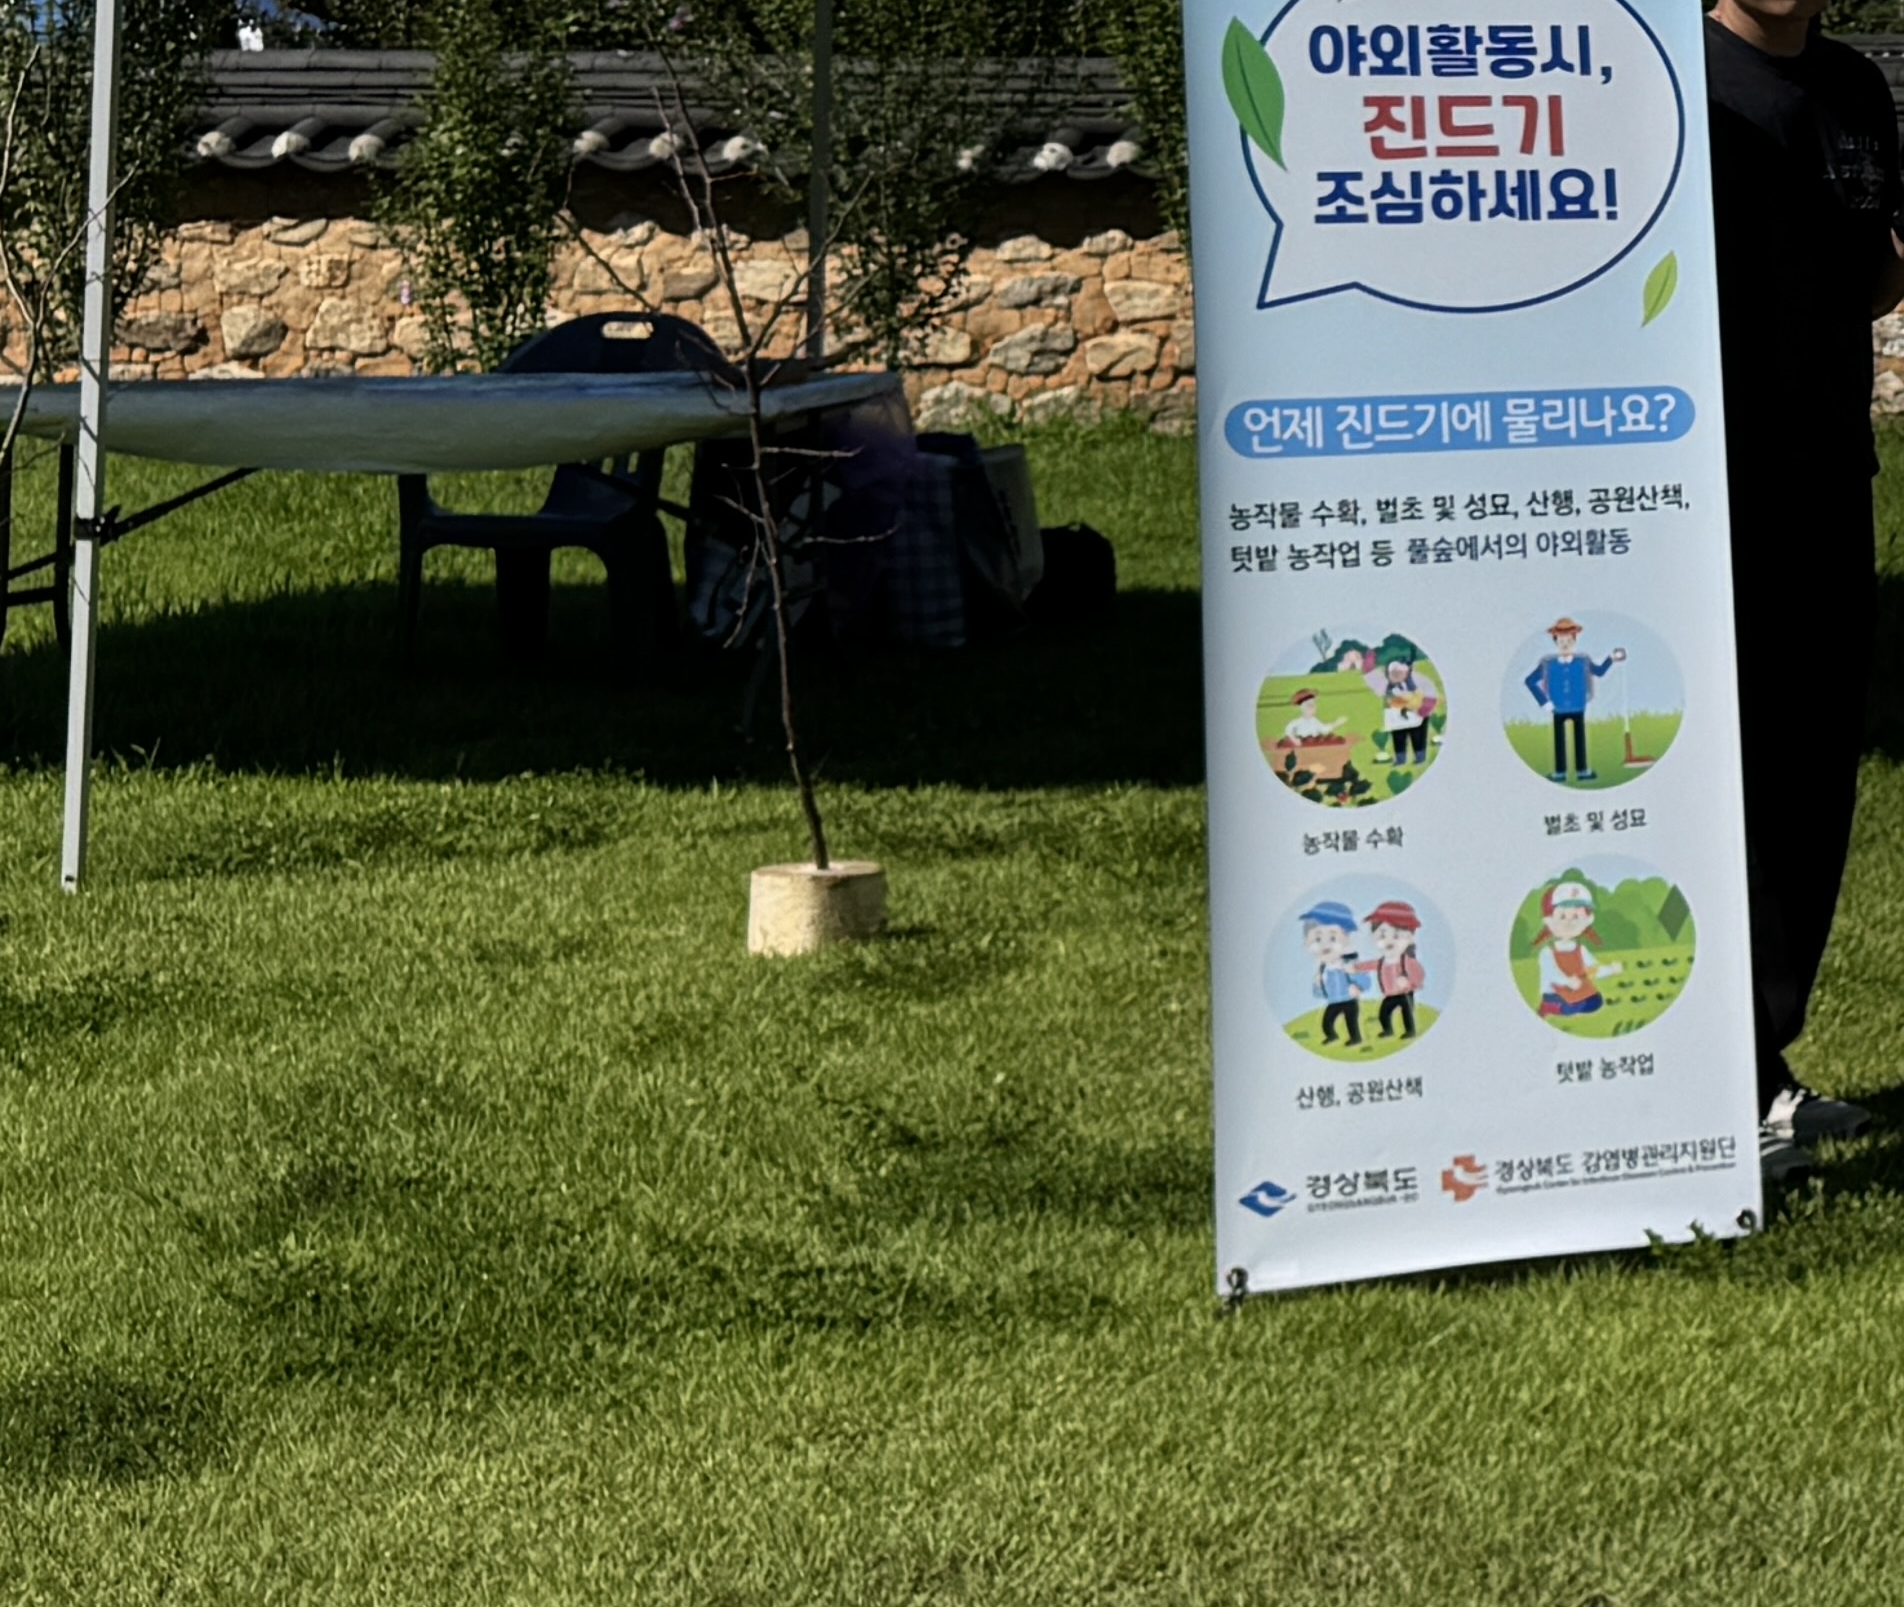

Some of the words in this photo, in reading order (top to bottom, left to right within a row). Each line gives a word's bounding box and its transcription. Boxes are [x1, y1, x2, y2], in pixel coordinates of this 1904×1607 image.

[1308, 24, 1612, 85] 야외활동시,
[1362, 94, 1565, 161] 진드기
[1314, 167, 1618, 225] 조심하세요!
[1244, 408, 1324, 455] 언제
[1336, 401, 1491, 449] 진드기에
[1502, 393, 1676, 444] 물리나요?
[1228, 501, 1303, 532] 농작물
[1310, 498, 1367, 528] 수확,
[1376, 496, 1425, 524] 벌초
[1433, 494, 1455, 522] 및
[1463, 493, 1519, 521] 성묘,
[1526, 489, 1581, 517] 산행,
[1588, 483, 1690, 515] 공원산책,
[1230, 544, 1279, 574] 텃밭
[1287, 540, 1361, 572] 농작업
[1370, 539, 1395, 568] 등
[1407, 532, 1527, 565] 풀숲에서의
[1536, 528, 1632, 558] 야외활동
[1303, 829, 1360, 856] 농작물
[1366, 825, 1404, 849] 수확
[1544, 813, 1581, 836] 벌초
[1586, 810, 1604, 833] 및
[1610, 808, 1647, 831] 성묘
[1347, 1076, 1423, 1106] 공원산책
[1556, 1059, 1593, 1084] 텃밭
[1600, 1052, 1654, 1080] 농작업
[1306, 1166, 1418, 1200] 경상북도
[1495, 1153, 1573, 1184] 경상북도
[1582, 1136, 1736, 1175] 감염병관리지원단
